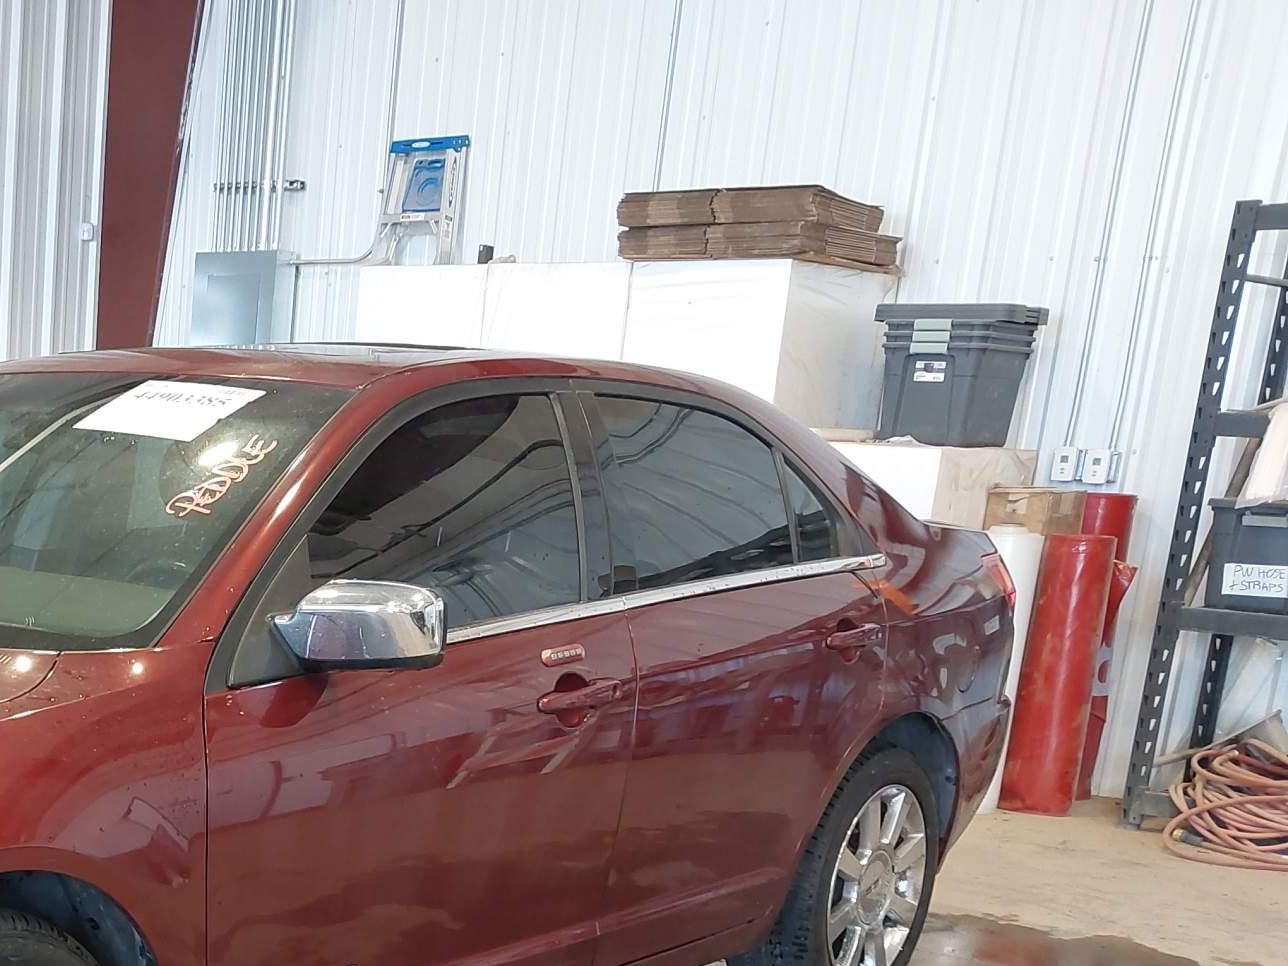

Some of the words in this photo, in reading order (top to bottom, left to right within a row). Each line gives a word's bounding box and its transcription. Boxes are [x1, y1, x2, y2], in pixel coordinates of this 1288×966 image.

[1233, 564, 1254, 578] PW
[1257, 567, 1286, 580] HOSE
[1239, 580, 1284, 593] STRAPS
